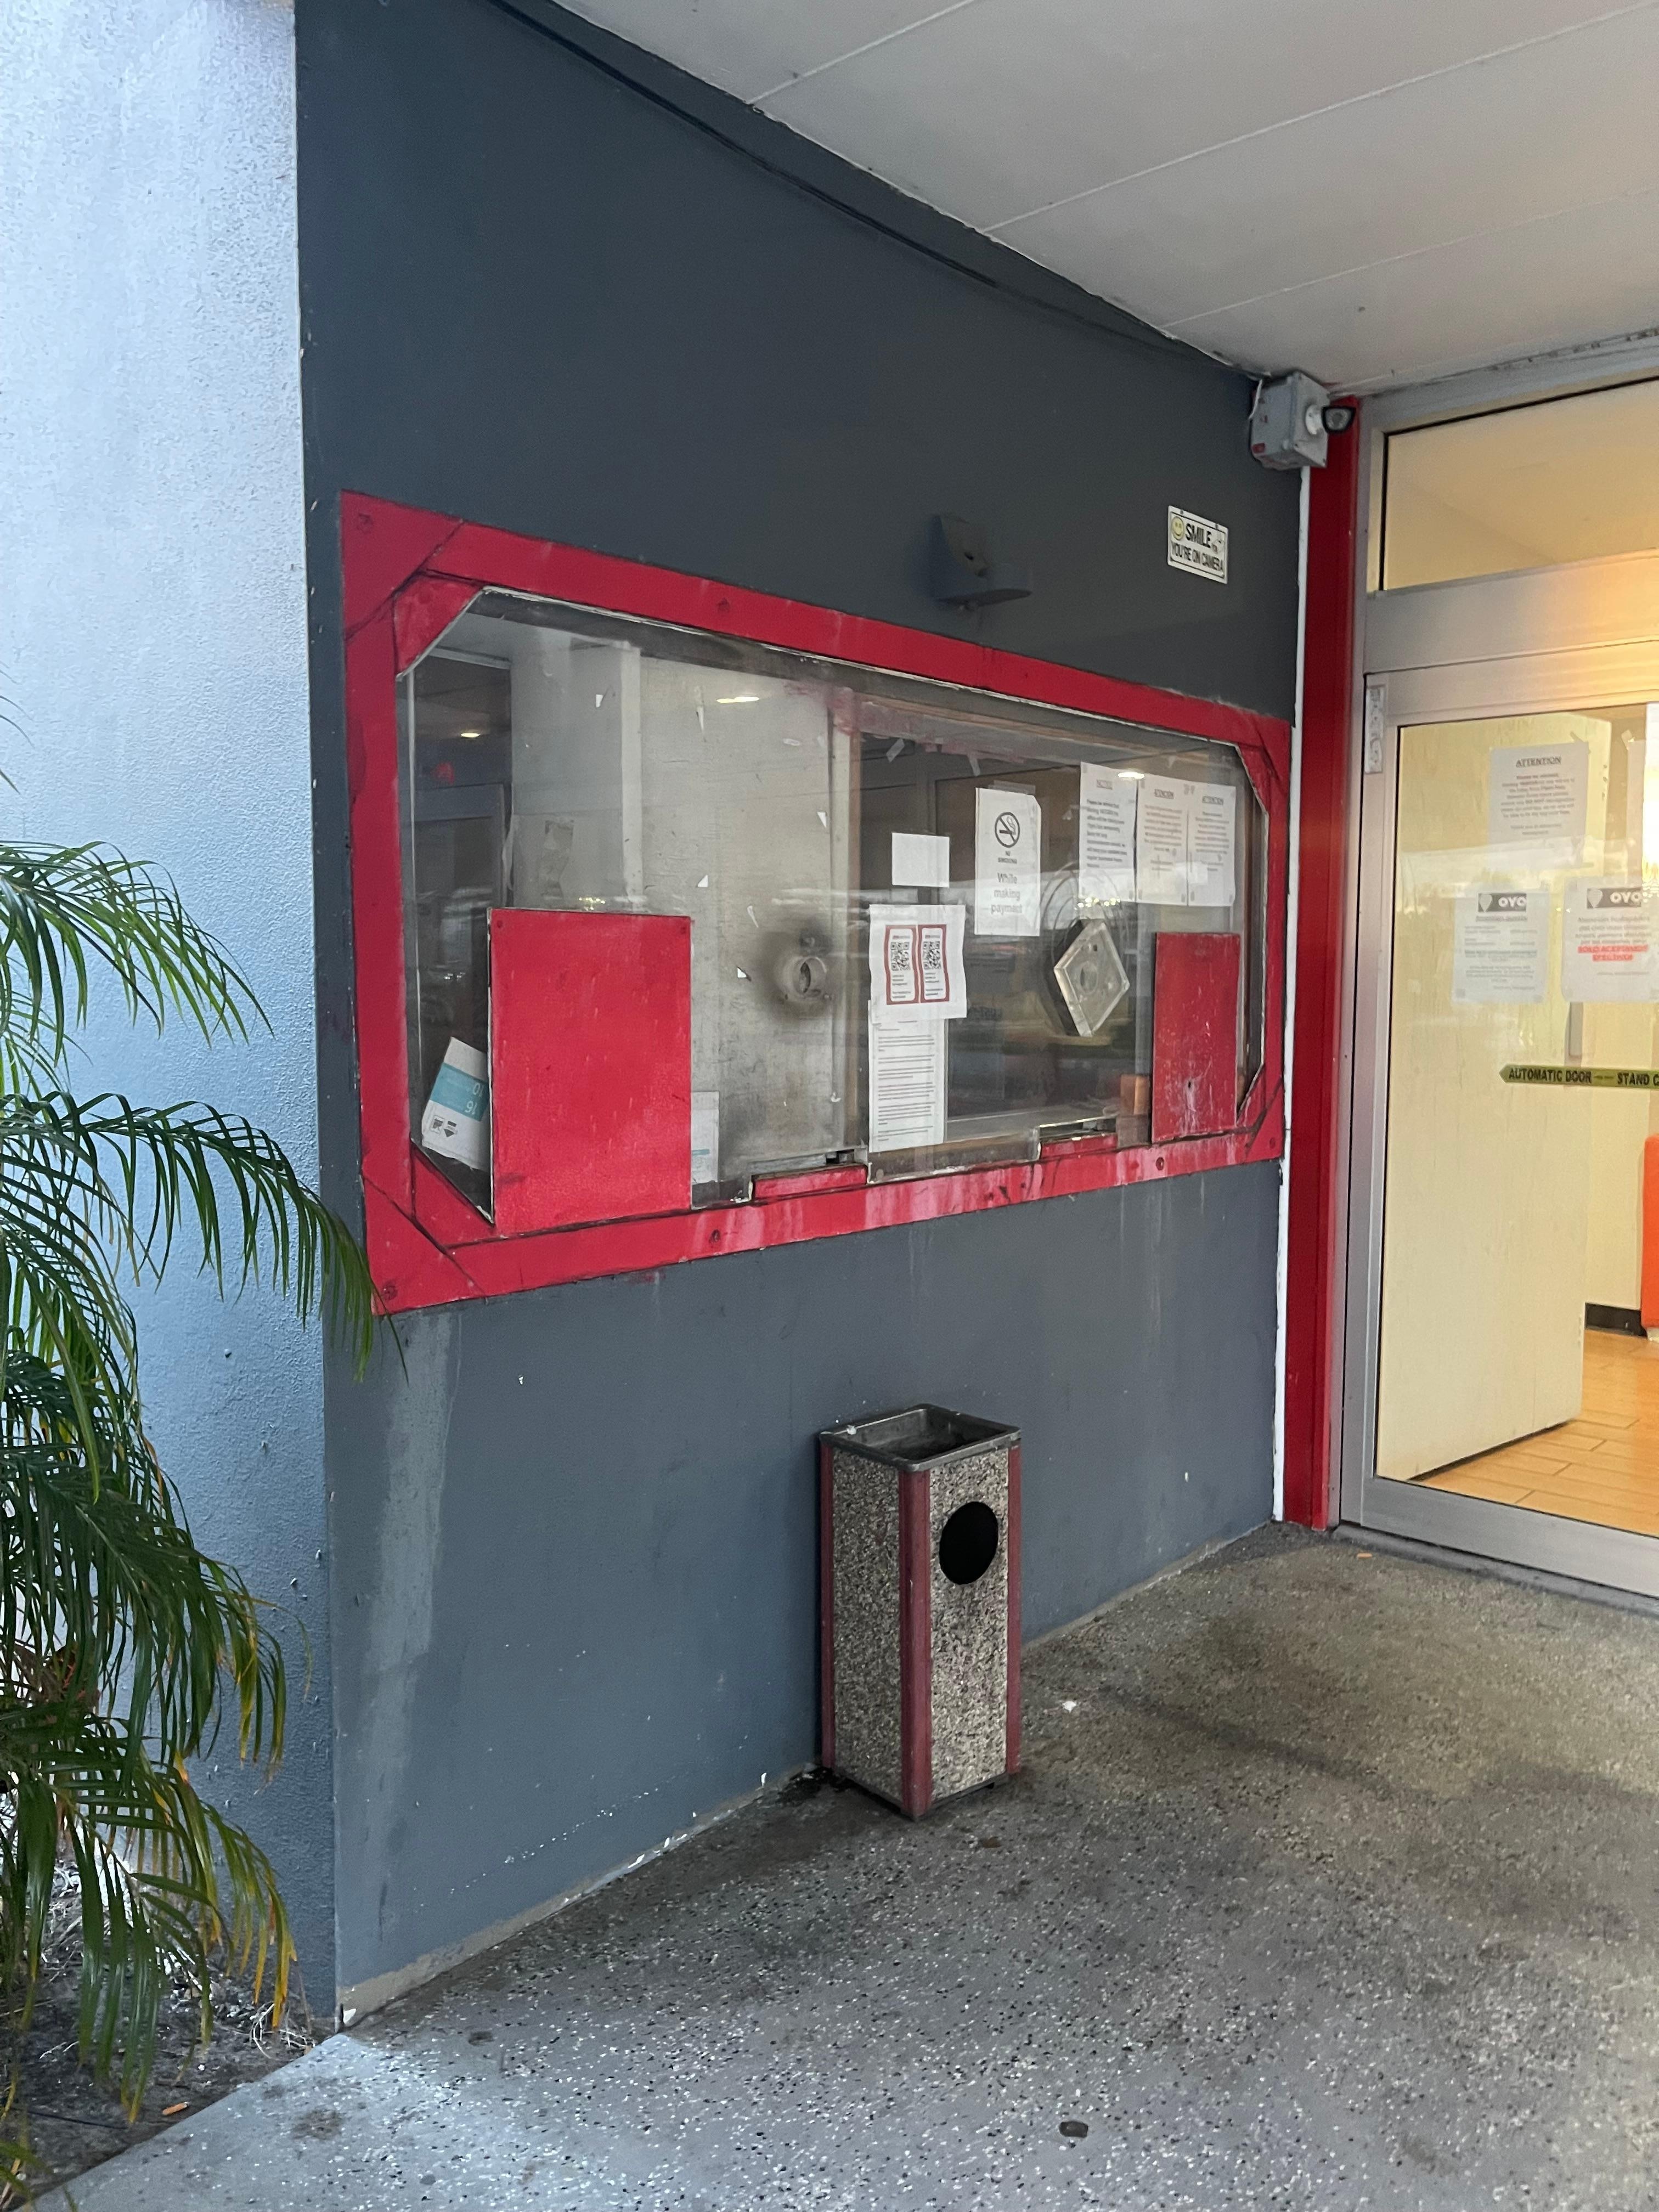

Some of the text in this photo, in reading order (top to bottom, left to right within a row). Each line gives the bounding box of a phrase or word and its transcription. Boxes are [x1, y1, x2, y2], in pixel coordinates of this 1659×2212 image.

[1186, 523, 1211, 549] SMILE
[1192, 549, 1200, 564] ON
[1202, 552, 1224, 571] CAMERA
[1516, 757, 1561, 768] ATTENTION
[997, 873, 1017, 884] While
[994, 888, 1020, 901] making
[991, 904, 1022, 916] payment
[1509, 1068, 1562, 1082] AUTOMATIC
[1566, 1070, 1591, 1084] DOOR
[1617, 1072, 1650, 1086] STAND
